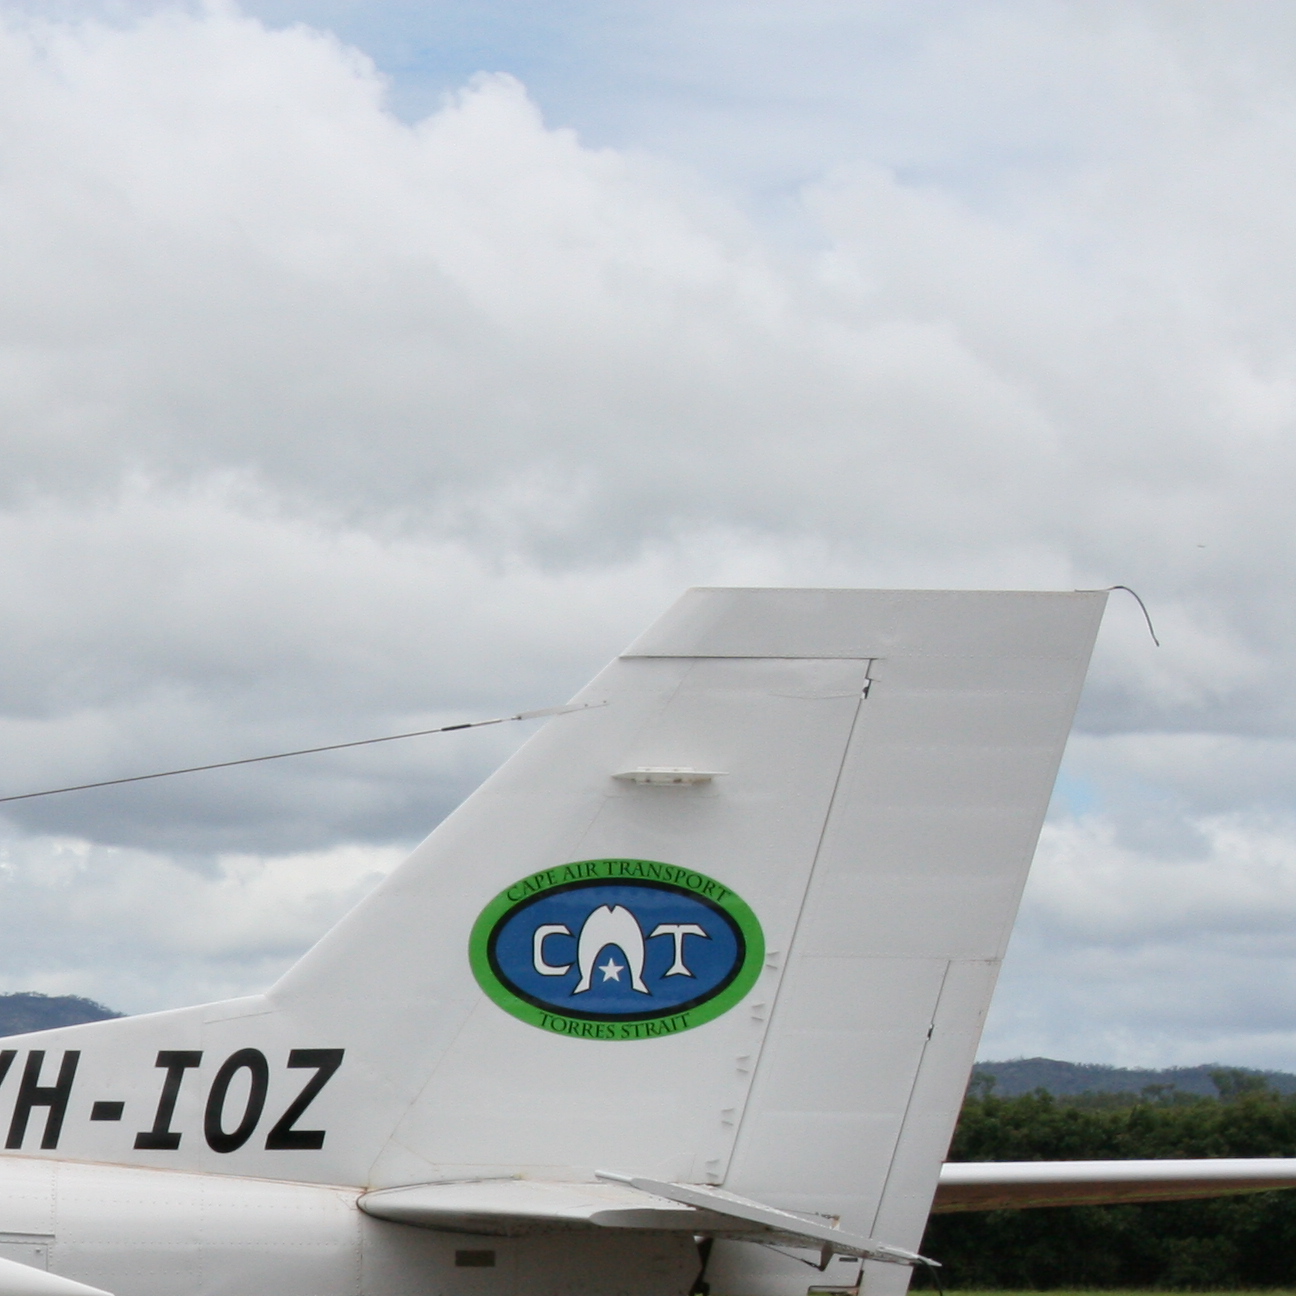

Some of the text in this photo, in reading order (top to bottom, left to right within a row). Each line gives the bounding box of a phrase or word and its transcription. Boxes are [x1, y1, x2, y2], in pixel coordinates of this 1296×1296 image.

[507, 861, 731, 902] CAPE AIR TRANSPORT
[533, 904, 712, 996] CAT
[539, 1012, 689, 1039] TORRES STRAIT
